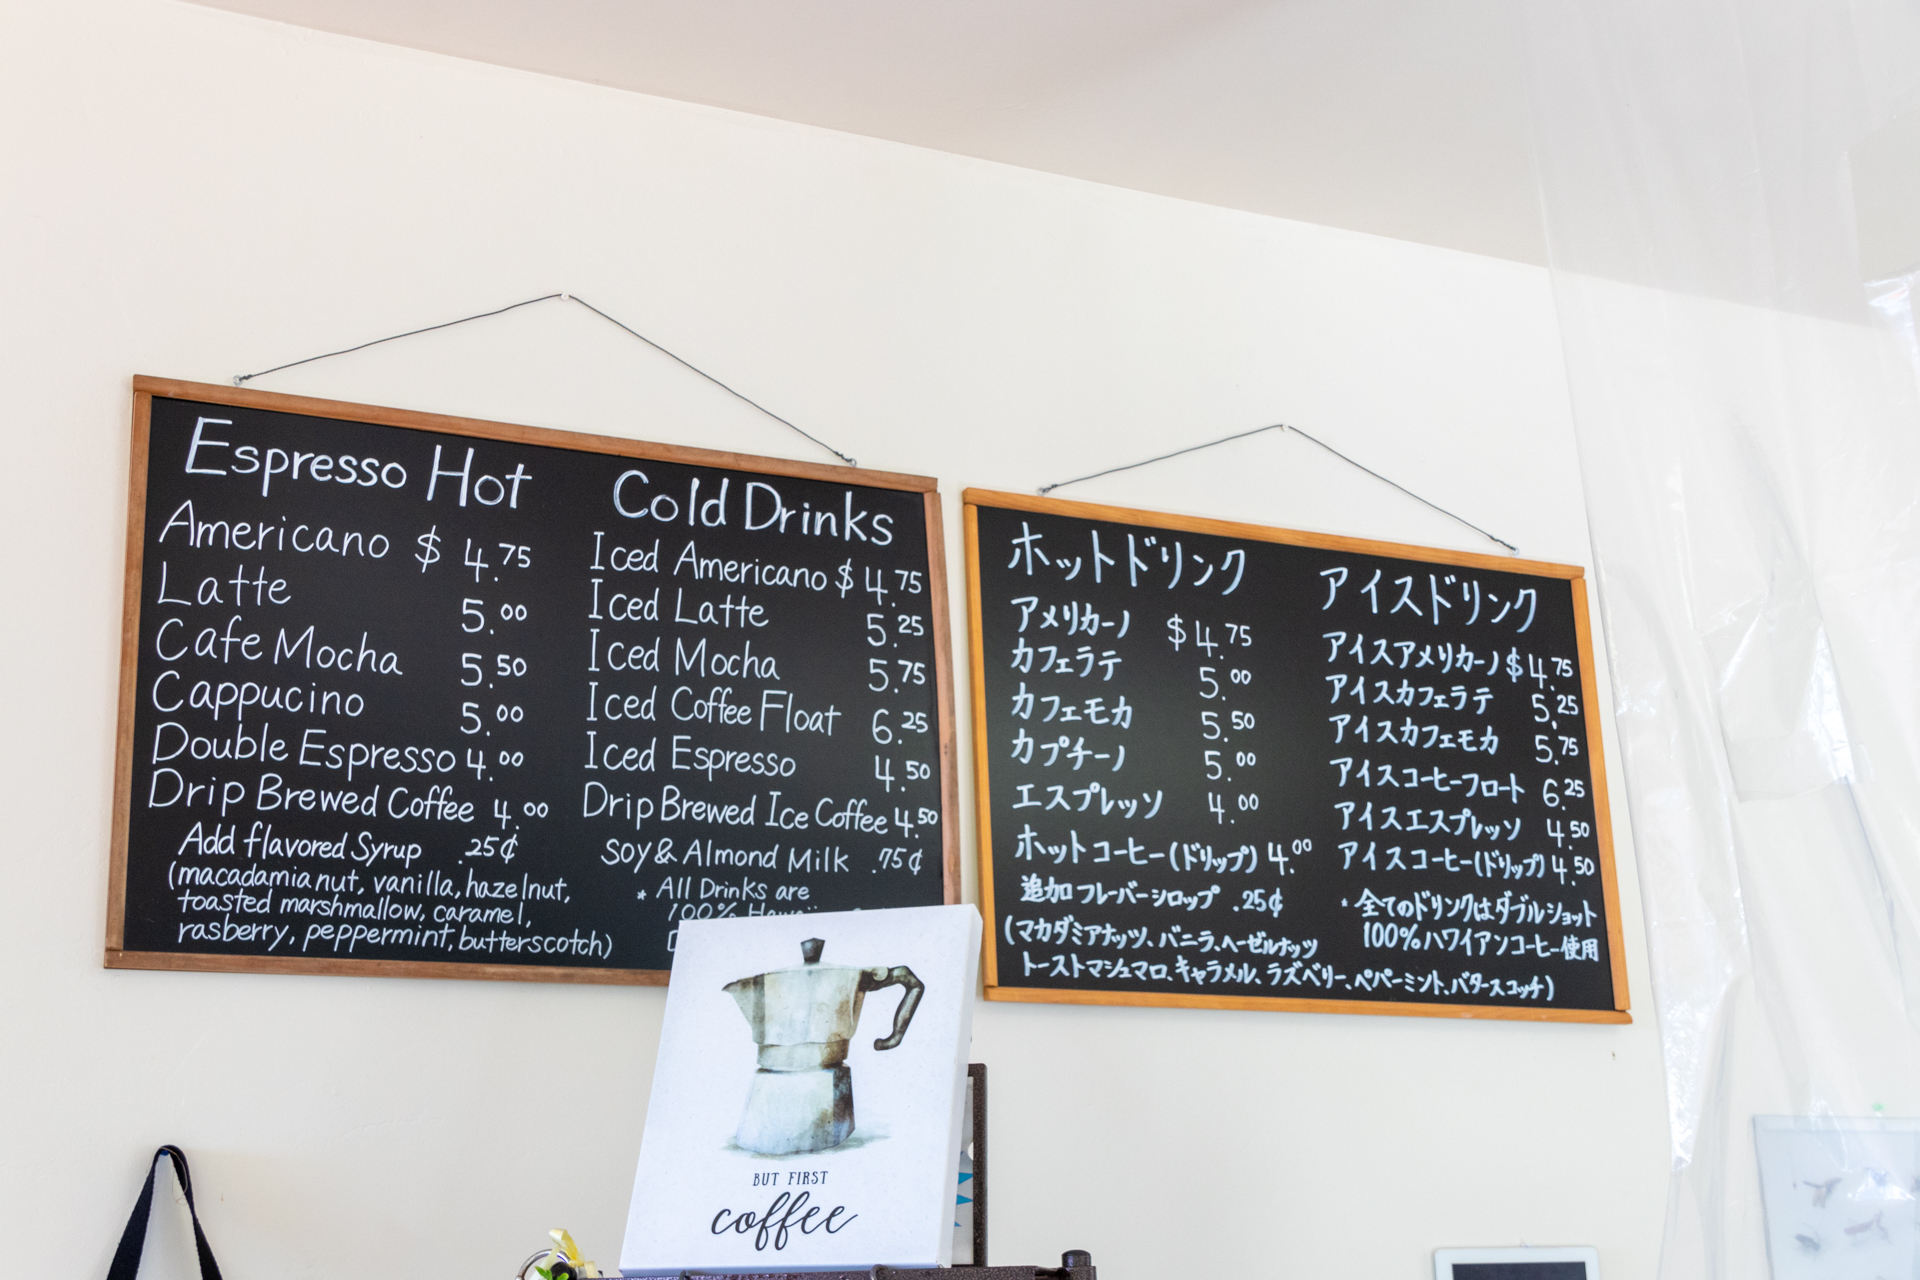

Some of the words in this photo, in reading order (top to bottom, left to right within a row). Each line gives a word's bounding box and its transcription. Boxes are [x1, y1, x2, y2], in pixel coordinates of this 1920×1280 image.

[184, 416, 407, 498] Espresso
[426, 444, 533, 509] Hot
[158, 499, 390, 559] Americano
[613, 469, 730, 527] Cold
[744, 481, 894, 546] Drinks
[157, 560, 292, 607] Latte
[589, 531, 660, 573] Iced
[673, 540, 828, 592] Americano
[588, 578, 660, 621] Iced
[674, 587, 770, 629] Latte
[156, 614, 263, 664] Cafe
[273, 625, 404, 676] Mocha
[587, 628, 661, 673] Iced
[675, 636, 781, 681] Mocha
[152, 669, 365, 722] Cappucino
[586, 681, 658, 722] Iced
[670, 685, 753, 726] Coffee
[759, 689, 842, 737] Float
[152, 721, 289, 765] Double
[298, 728, 457, 782] Espresso
[584, 730, 657, 772] Iced
[671, 734, 797, 782] Espresso
[148, 767, 246, 818] Drip
[256, 772, 380, 818] Brewed
[387, 784, 475, 823] Coffee
[583, 780, 654, 831] Drip
[660, 784, 757, 826] Brewed
[764, 790, 809, 830] Ice
[814, 797, 889, 835] Coffee
[177, 821, 236, 856] Add
[243, 820, 349, 860] flavored
[350, 830, 422, 869] Syrup
[600, 838, 653, 874] Soy
[653, 837, 678, 865] &
[682, 838, 780, 869] Almond
[787, 845, 850, 874] Milk
[177, 887, 273, 914] toasted
[279, 893, 426, 922] marshmallow,
[433, 901, 532, 929] caramel,
[373, 869, 461, 900] vanilla,
[465, 867, 570, 904] hazelnut,
[655, 875, 692, 900] All
[699, 876, 768, 901] Drinks
[775, 885, 810, 901] are
[177, 912, 295, 952] rasberry,
[302, 922, 456, 953] peppermint,
[458, 924, 613, 960] butterscotch)
[753, 1173, 779, 1186] BUT
[788, 1171, 828, 1185] FIRST
[711, 1191, 858, 1251] coffee
